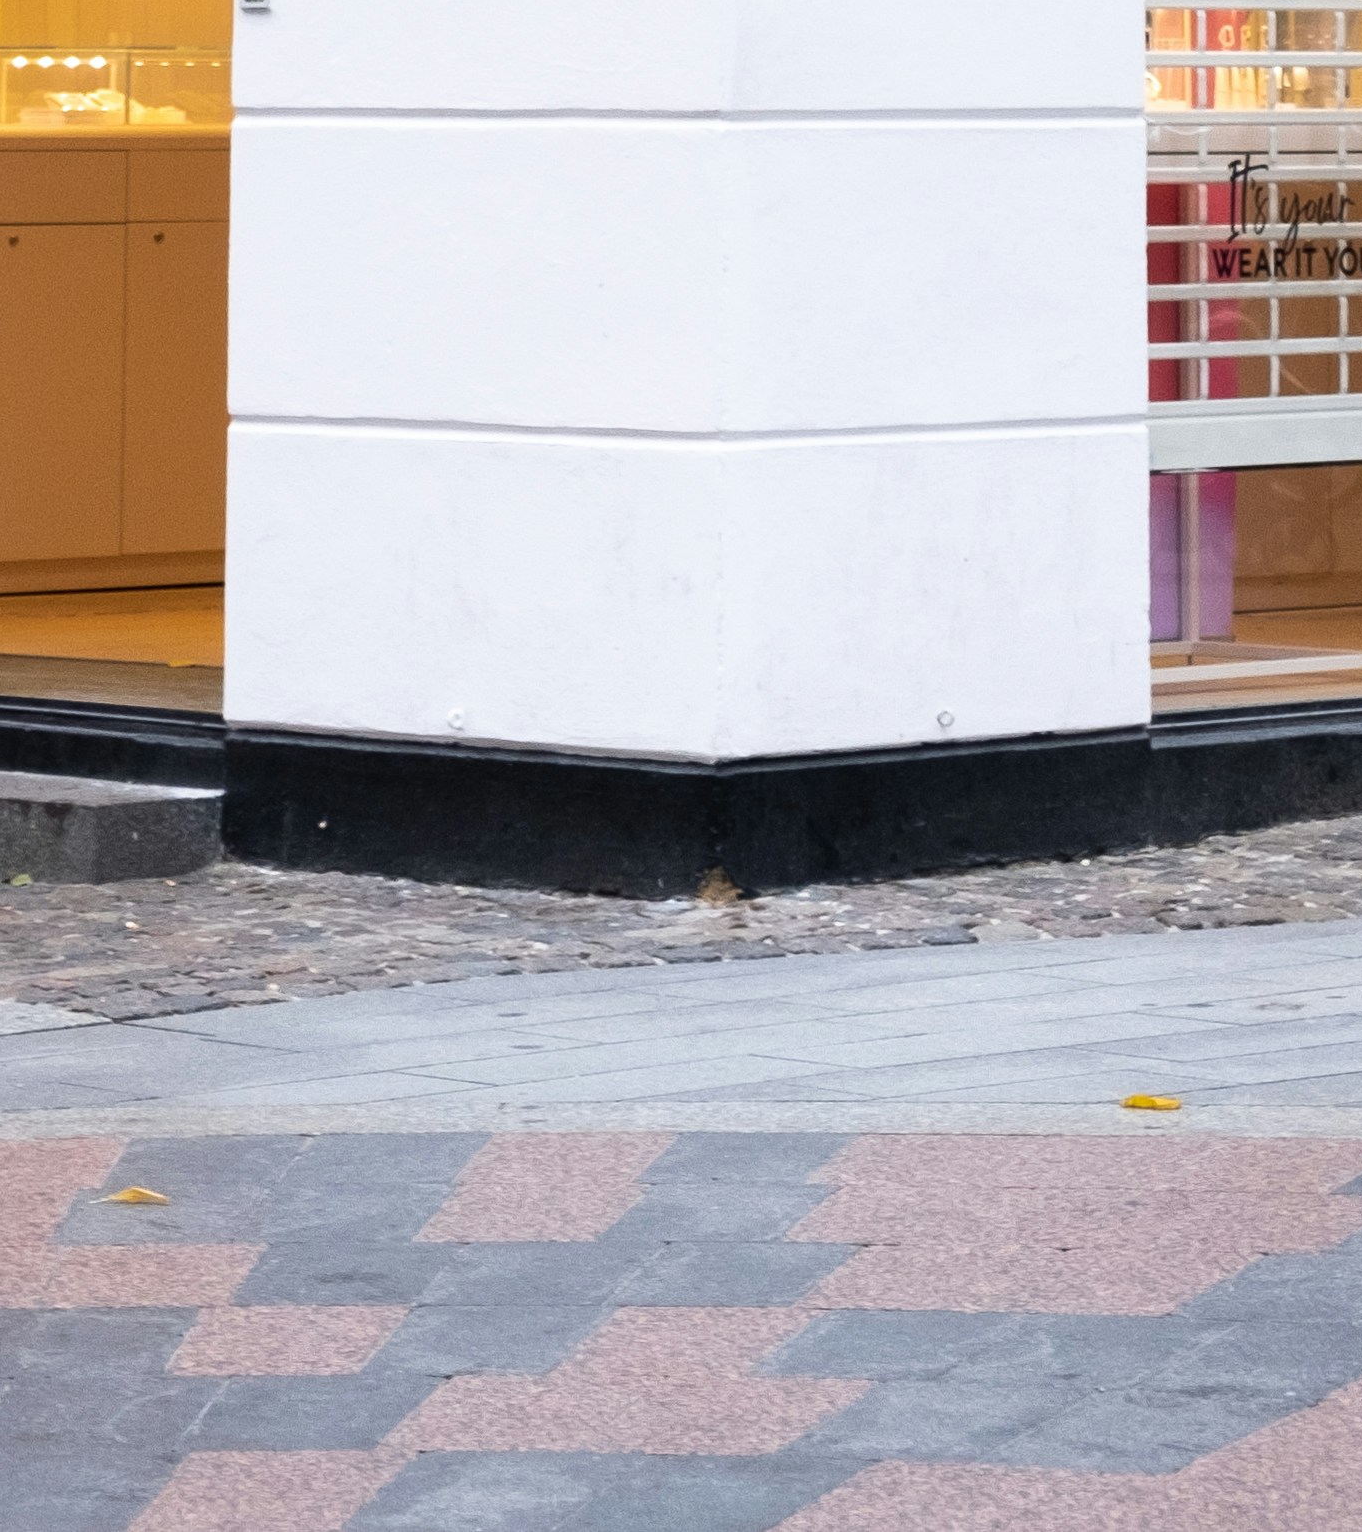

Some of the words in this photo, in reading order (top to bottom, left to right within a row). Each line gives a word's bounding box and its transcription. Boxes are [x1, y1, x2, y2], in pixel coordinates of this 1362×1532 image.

[1227, 153, 1269, 244] It's
[1280, 192, 1355, 254] your
[1212, 247, 1288, 279] WEAR
[1294, 246, 1317, 278] IT
